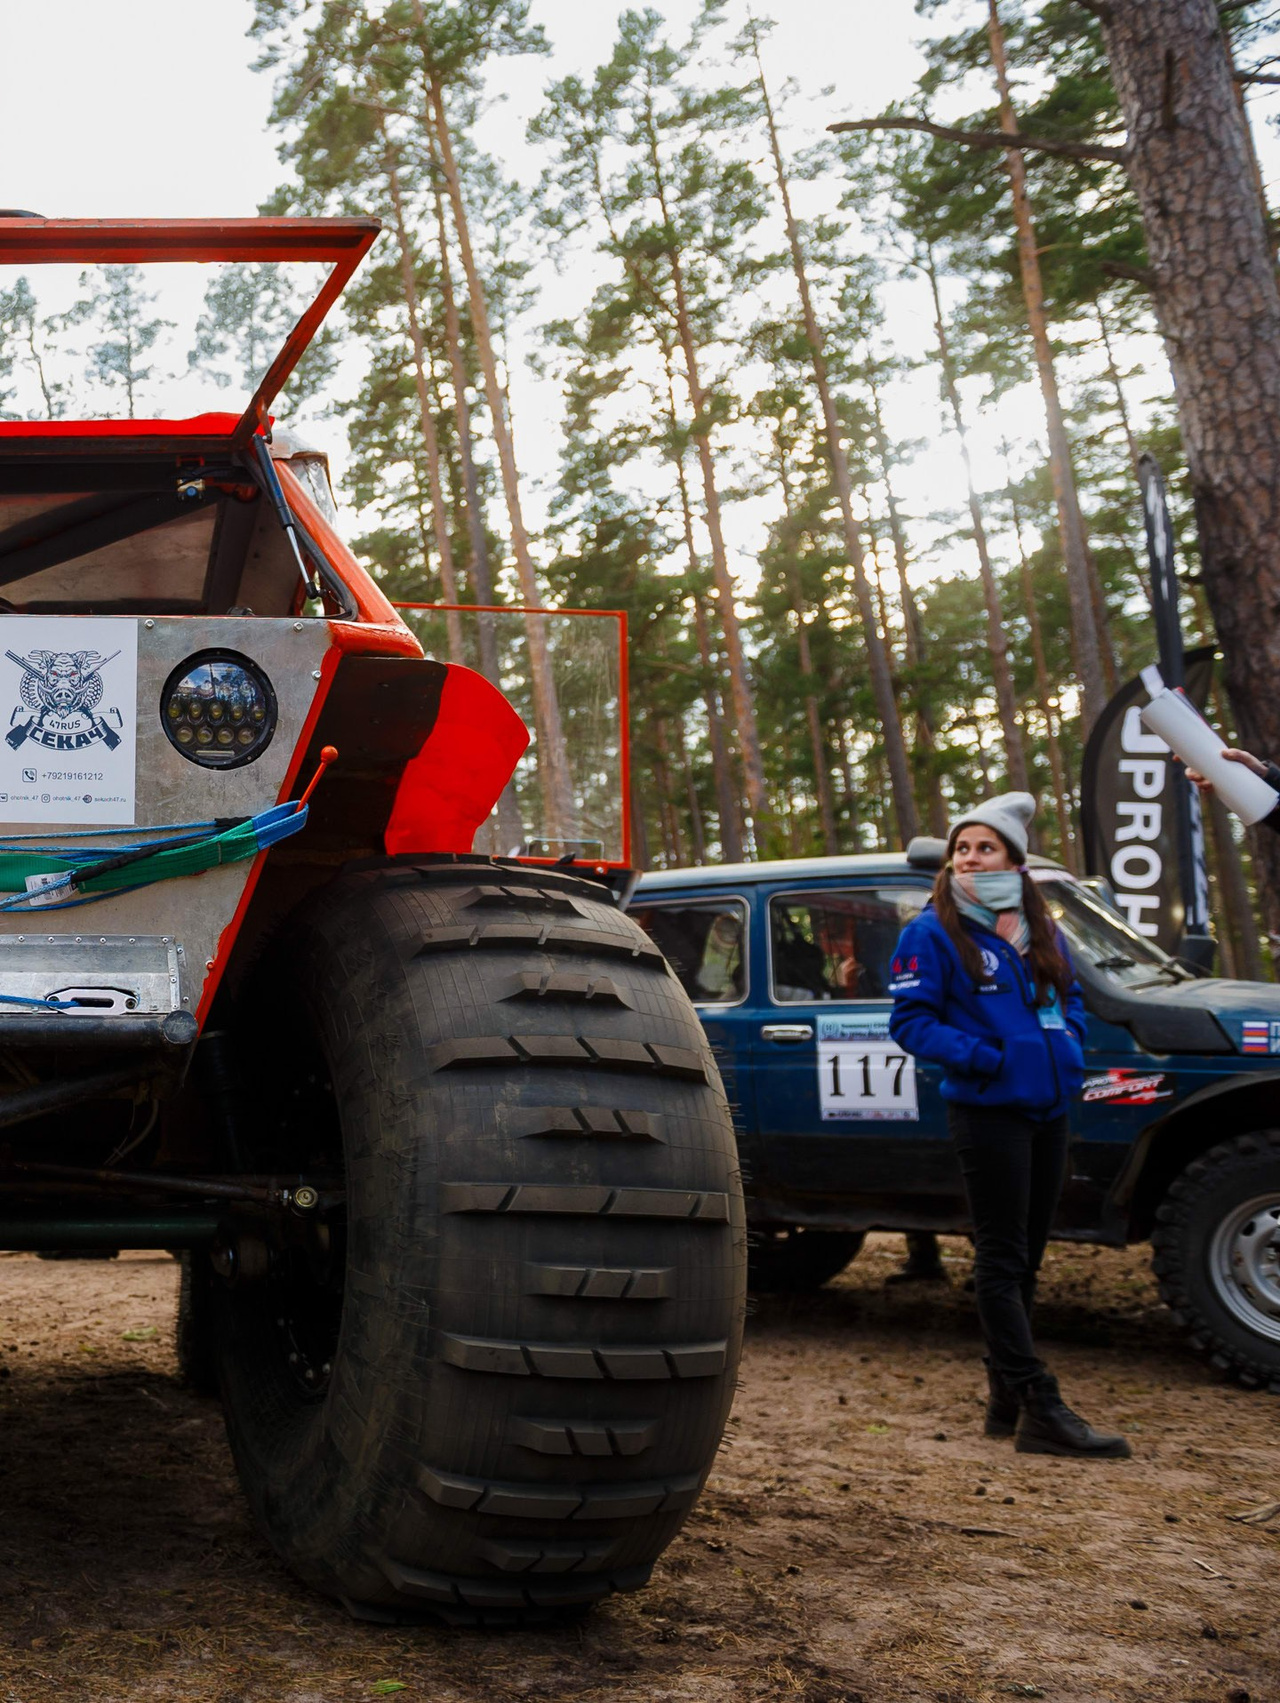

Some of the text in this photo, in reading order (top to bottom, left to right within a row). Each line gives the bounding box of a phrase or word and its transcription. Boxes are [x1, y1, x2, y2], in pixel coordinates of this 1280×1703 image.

[49, 719, 81, 730] 47RUS
[29, 726, 104, 749] СЕКАЧ
[42, 772, 104, 781] +79219161212
[828, 1055, 908, 1097] 117
